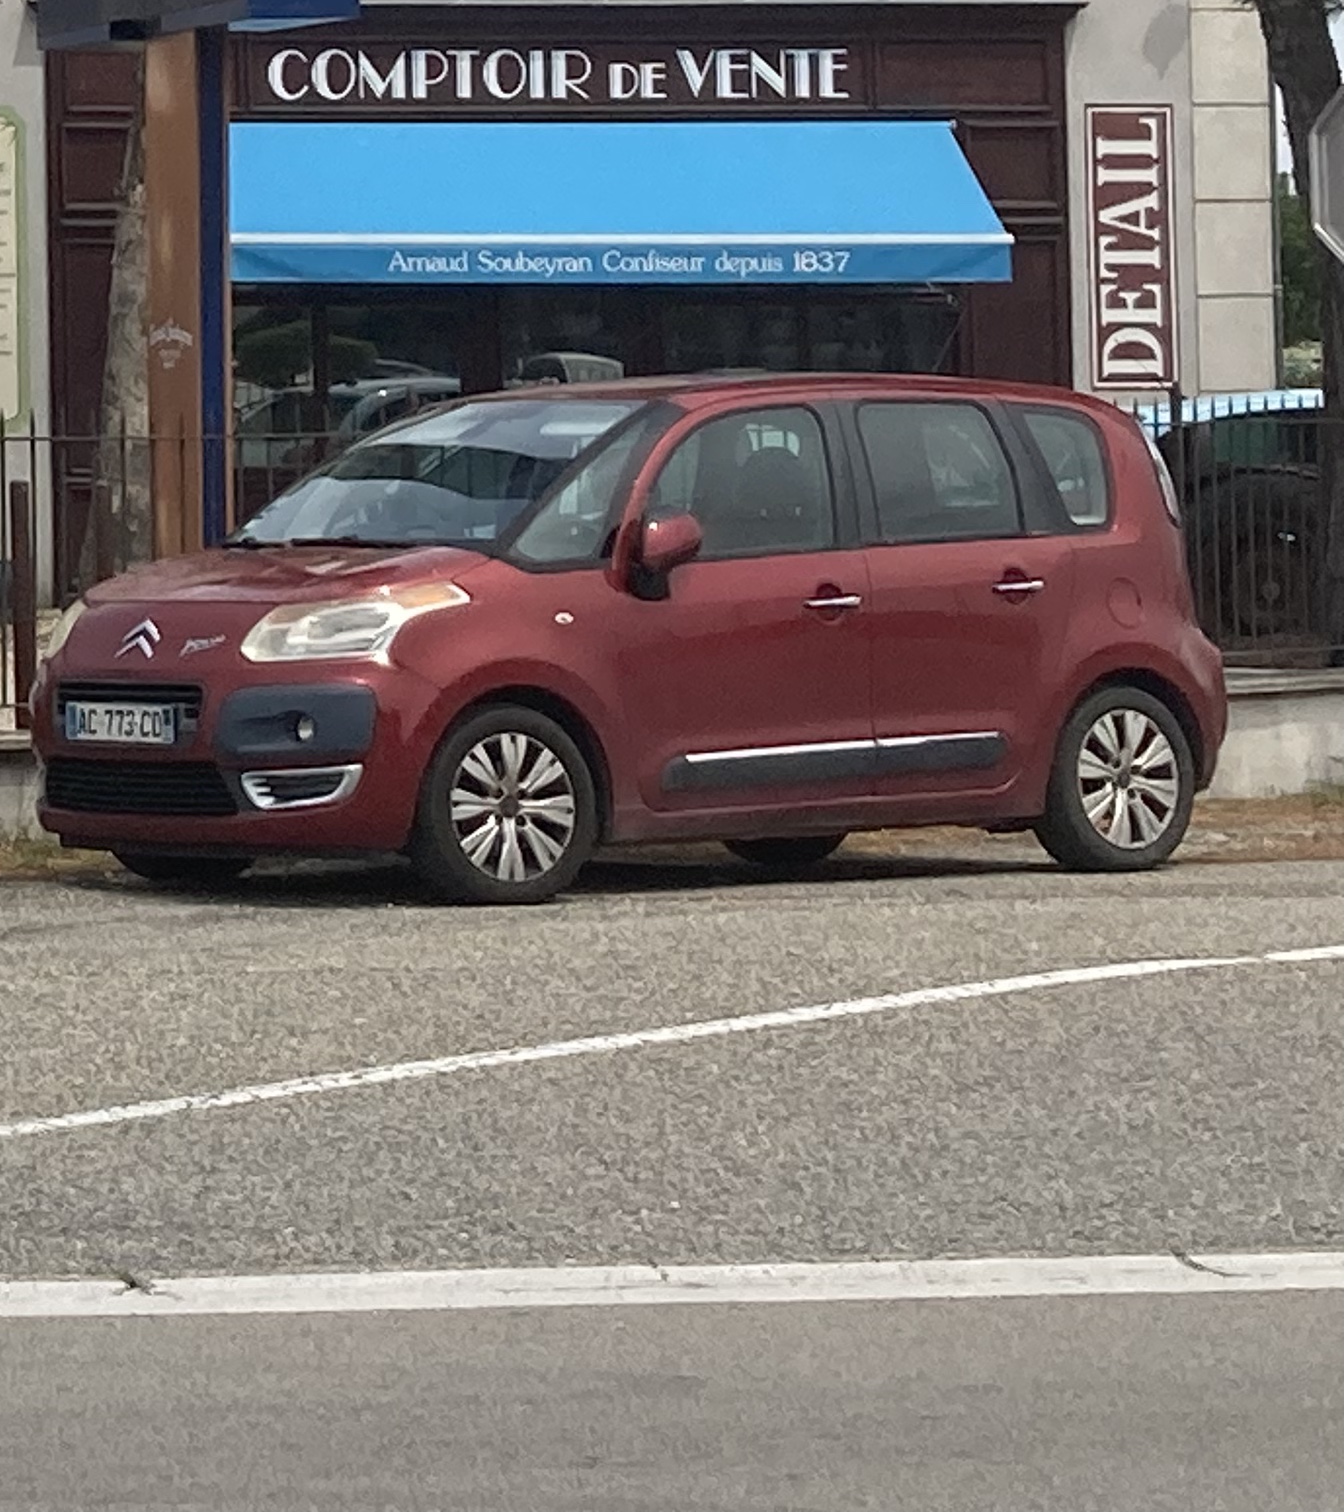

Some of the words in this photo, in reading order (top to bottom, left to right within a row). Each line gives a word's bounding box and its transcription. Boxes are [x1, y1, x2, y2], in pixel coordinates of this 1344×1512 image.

[268, 48, 592, 101] COMPTOIR
[609, 62, 667, 99] DE
[676, 48, 850, 99] VENTE
[388, 251, 469, 273] Arnaud
[477, 250, 593, 278] Soubeyran
[602, 250, 706, 272] Confiseur
[714, 250, 784, 278] depuis
[793, 251, 851, 273] 1837
[1097, 117, 1165, 379] DETAIL
